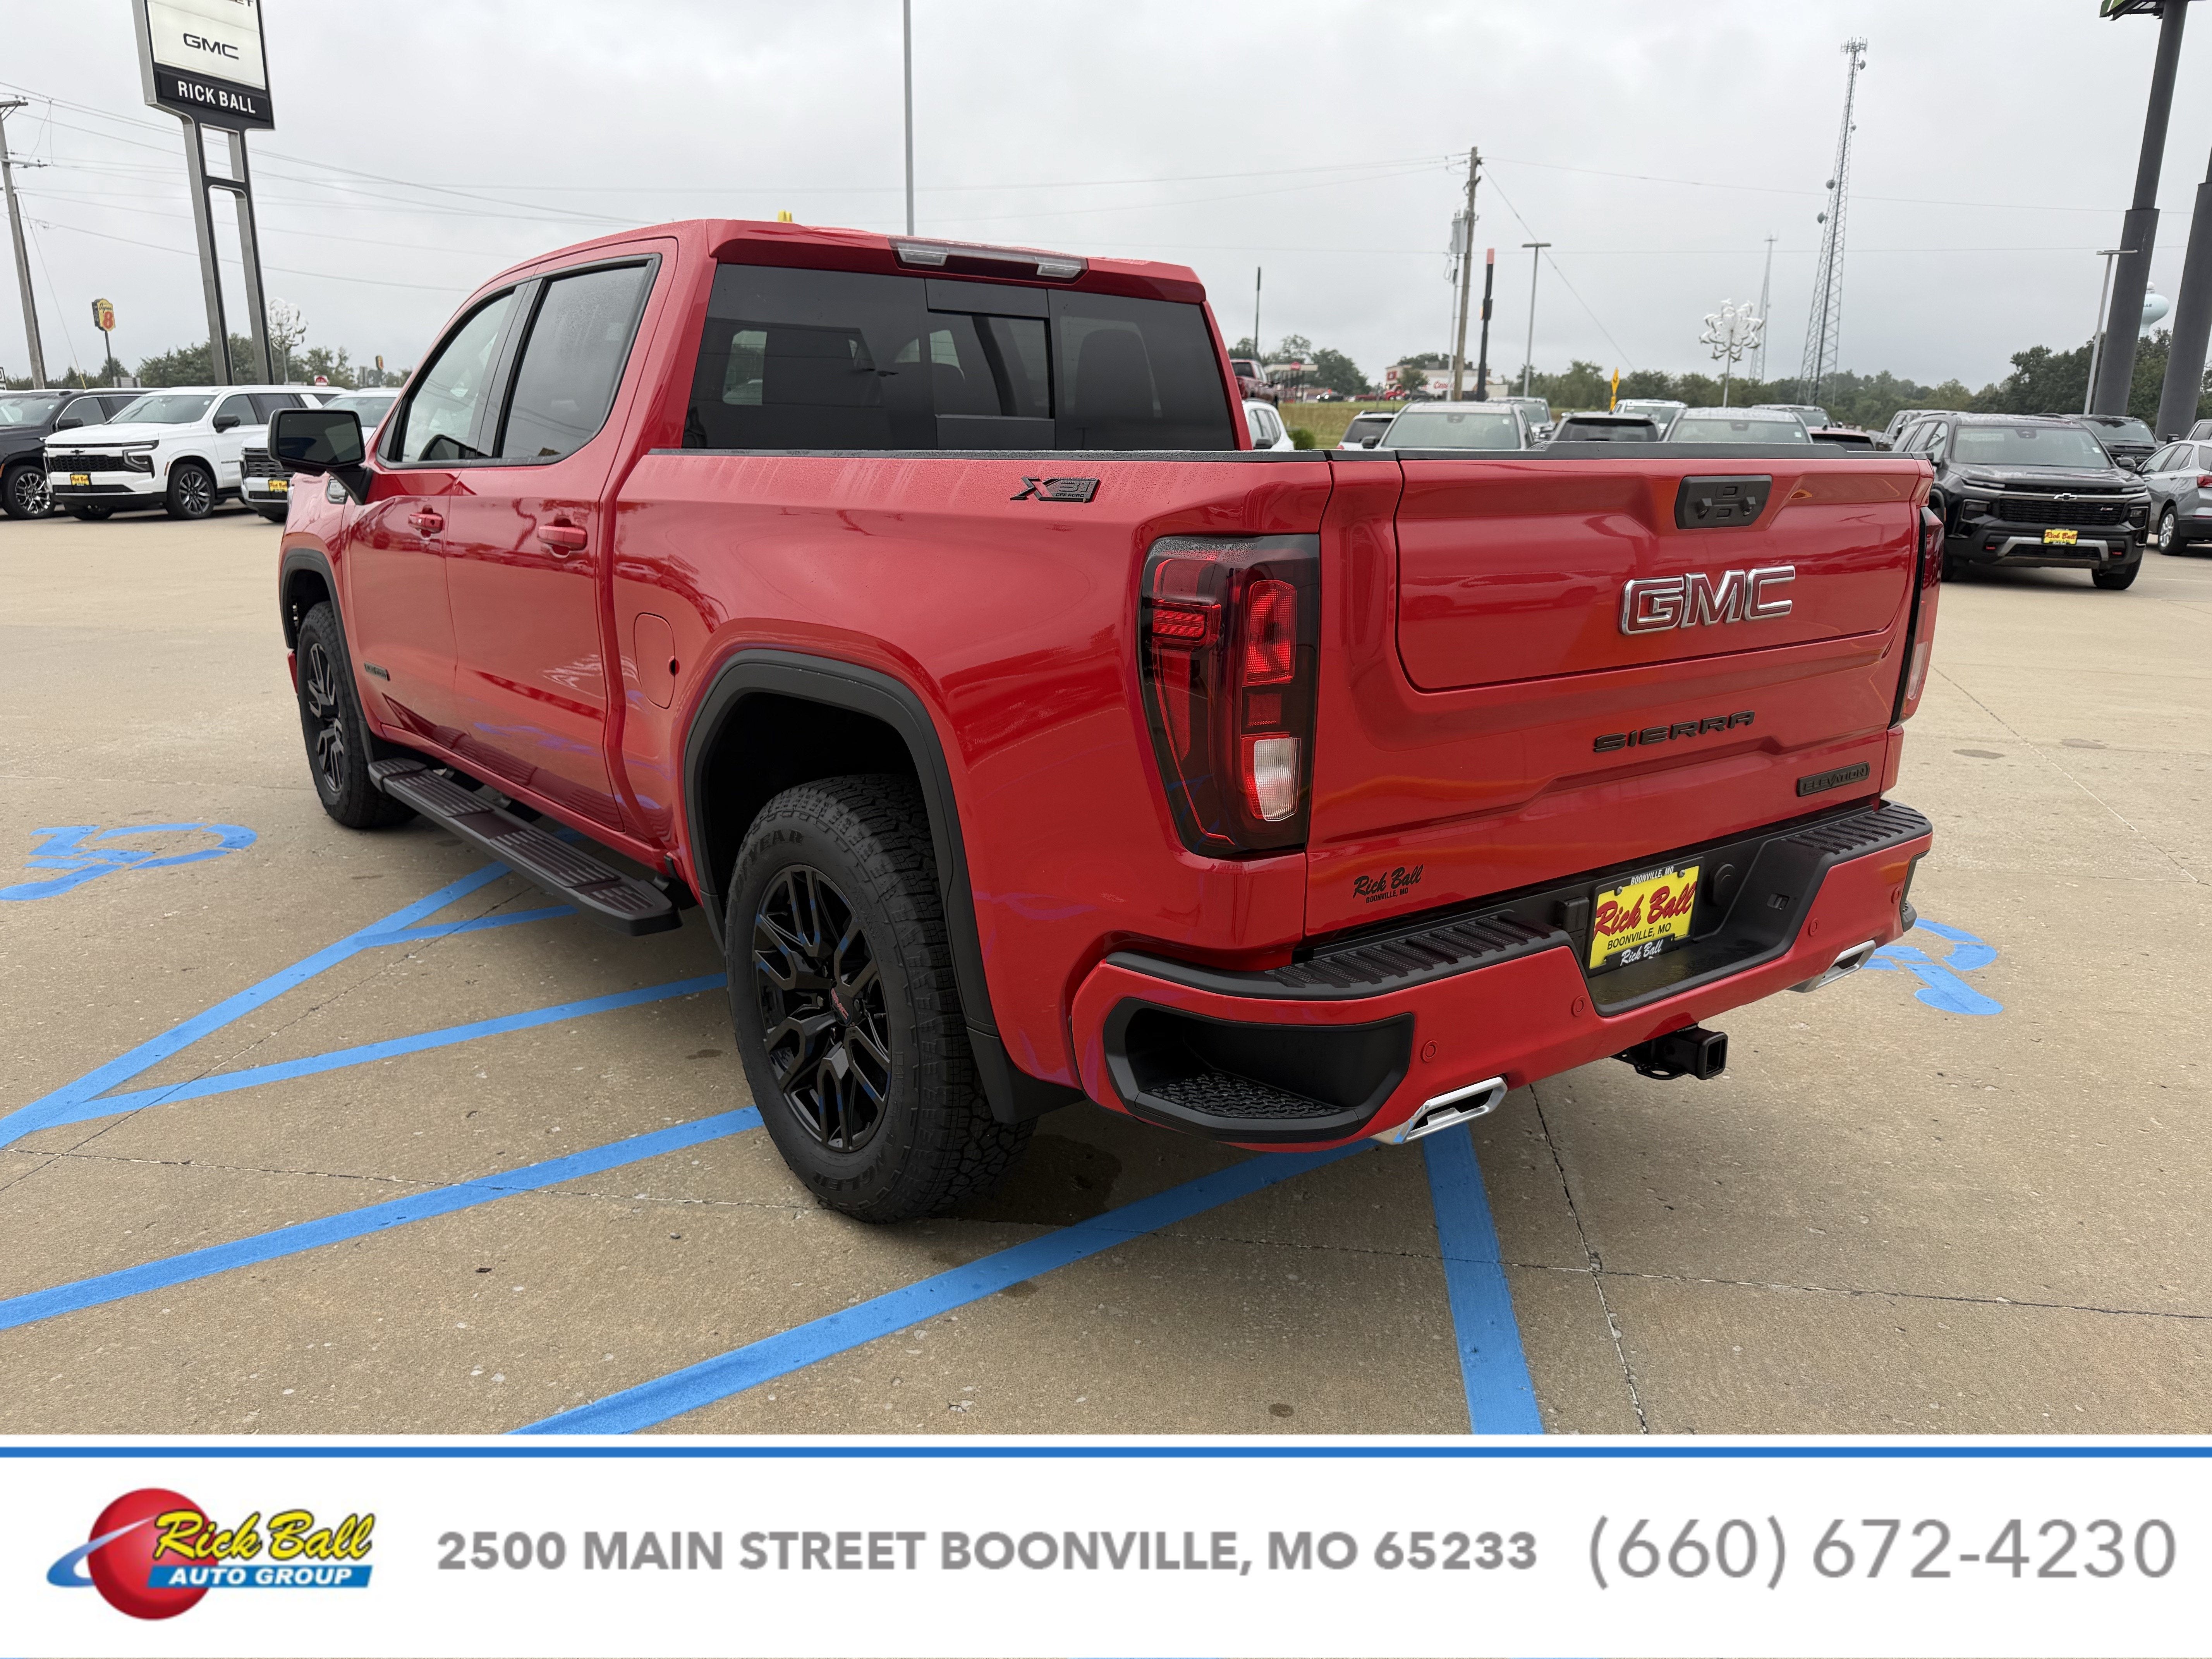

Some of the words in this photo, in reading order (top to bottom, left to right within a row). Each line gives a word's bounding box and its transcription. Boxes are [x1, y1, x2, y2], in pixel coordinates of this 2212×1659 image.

[184, 33, 239, 60] GMC
[177, 80, 216, 105] RICK
[219, 91, 256, 114] BALL
[102, 311, 113, 329] 8
[1619, 565, 1796, 635] GMC
[1593, 710, 1755, 752] SIERRA
[1804, 768, 1864, 791] ELEVATION
[1352, 871, 1387, 898] Rick
[1391, 864, 1424, 889] Ball
[1631, 869, 1663, 886] BOONVILLE,
[1665, 866, 1674, 875] MO
[1365, 890, 1398, 903] BOONVILLE,
[1400, 887, 1408, 896] MO
[1593, 893, 1644, 942] Rick
[1647, 881, 1697, 924] Ball
[1607, 927, 1655, 950] BOONVILLE,
[1657, 922, 1671, 934] MO
[1620, 945, 1642, 966] Rick
[1643, 939, 1663, 958] Ball
